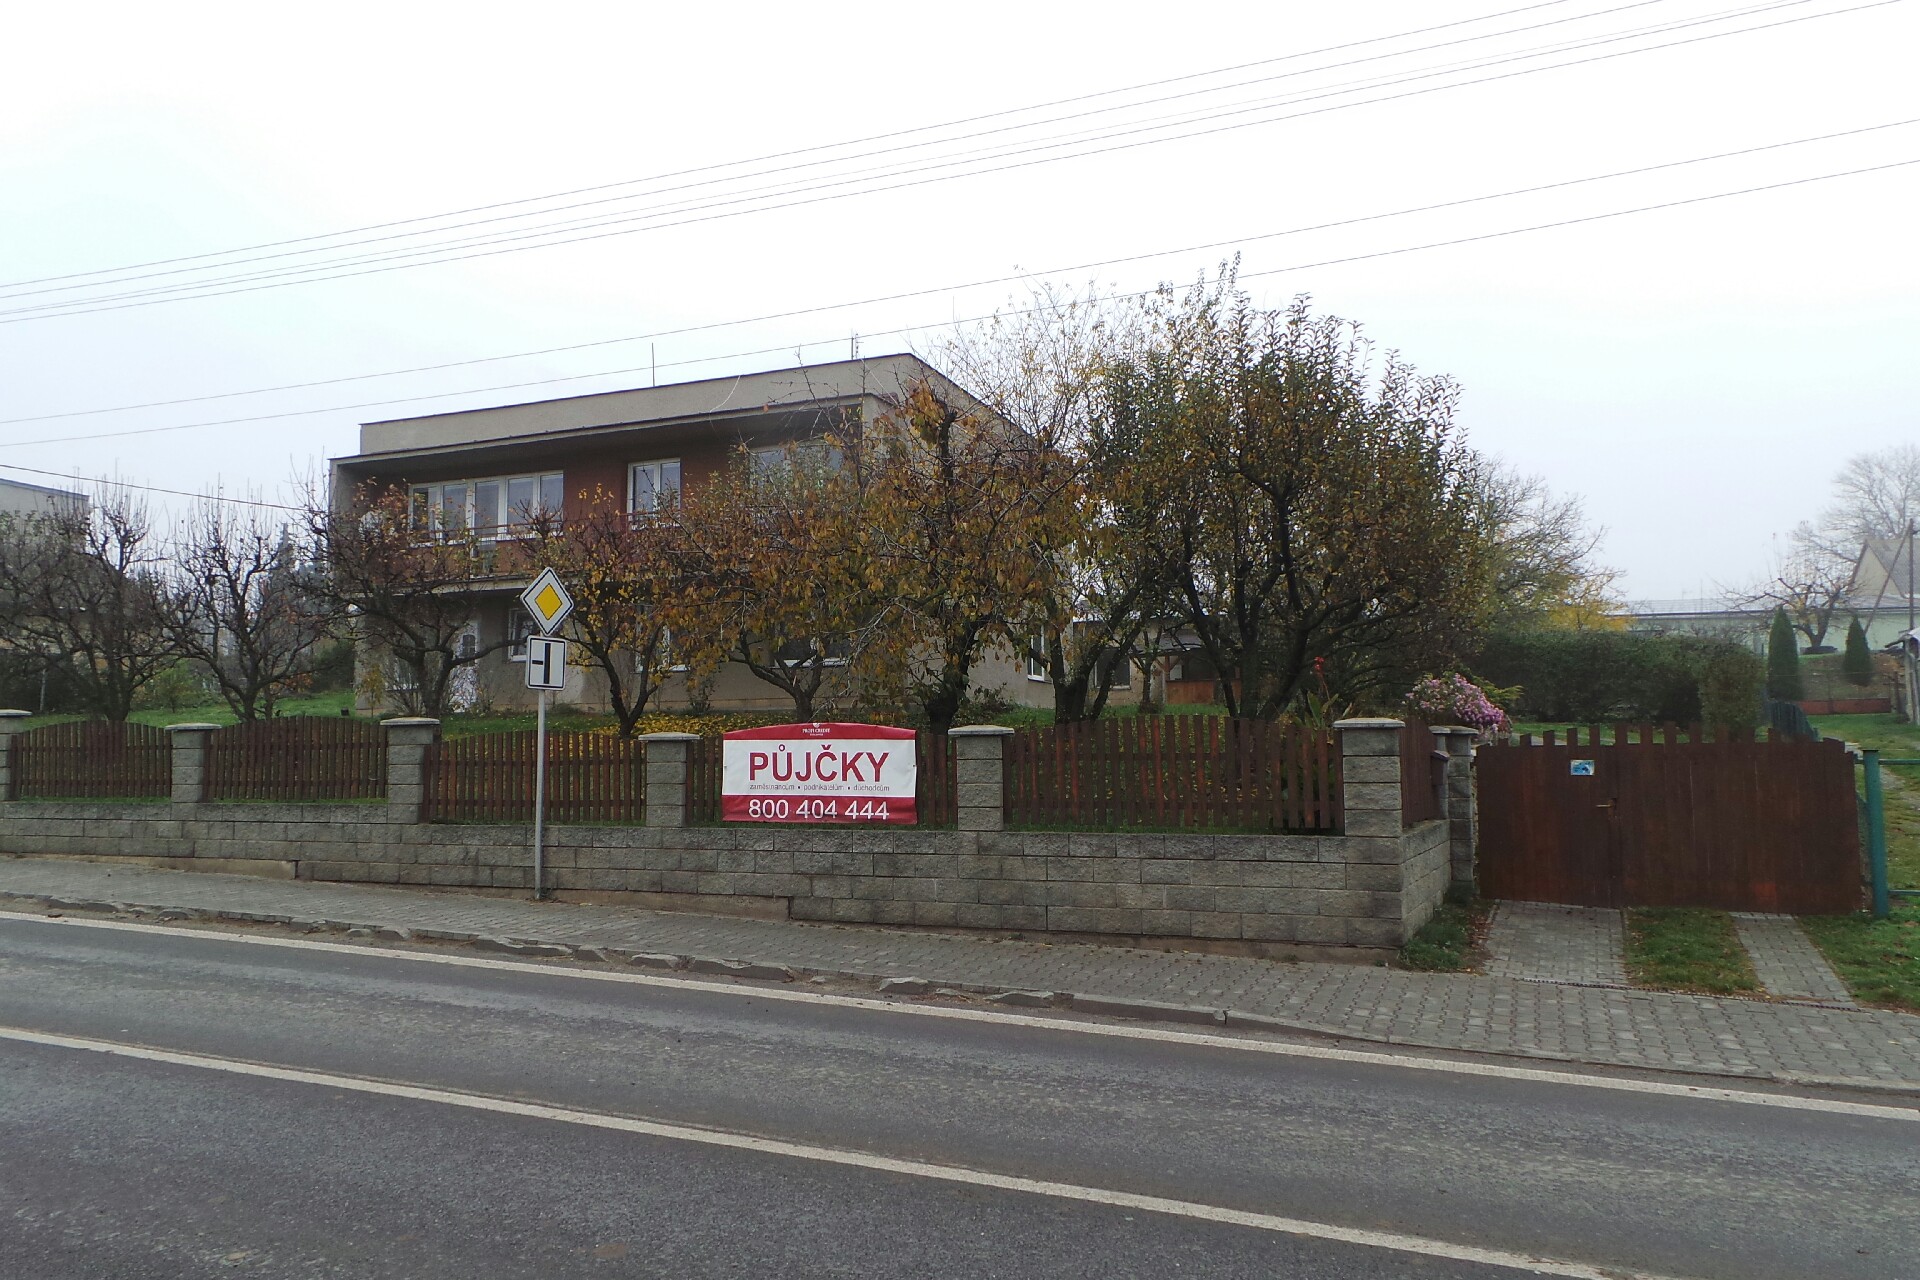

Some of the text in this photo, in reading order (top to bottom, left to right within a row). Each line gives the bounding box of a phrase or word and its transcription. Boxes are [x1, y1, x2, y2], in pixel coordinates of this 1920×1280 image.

[749, 744, 889, 782] PŮJČKY
[748, 799, 889, 820] 800 404 444
